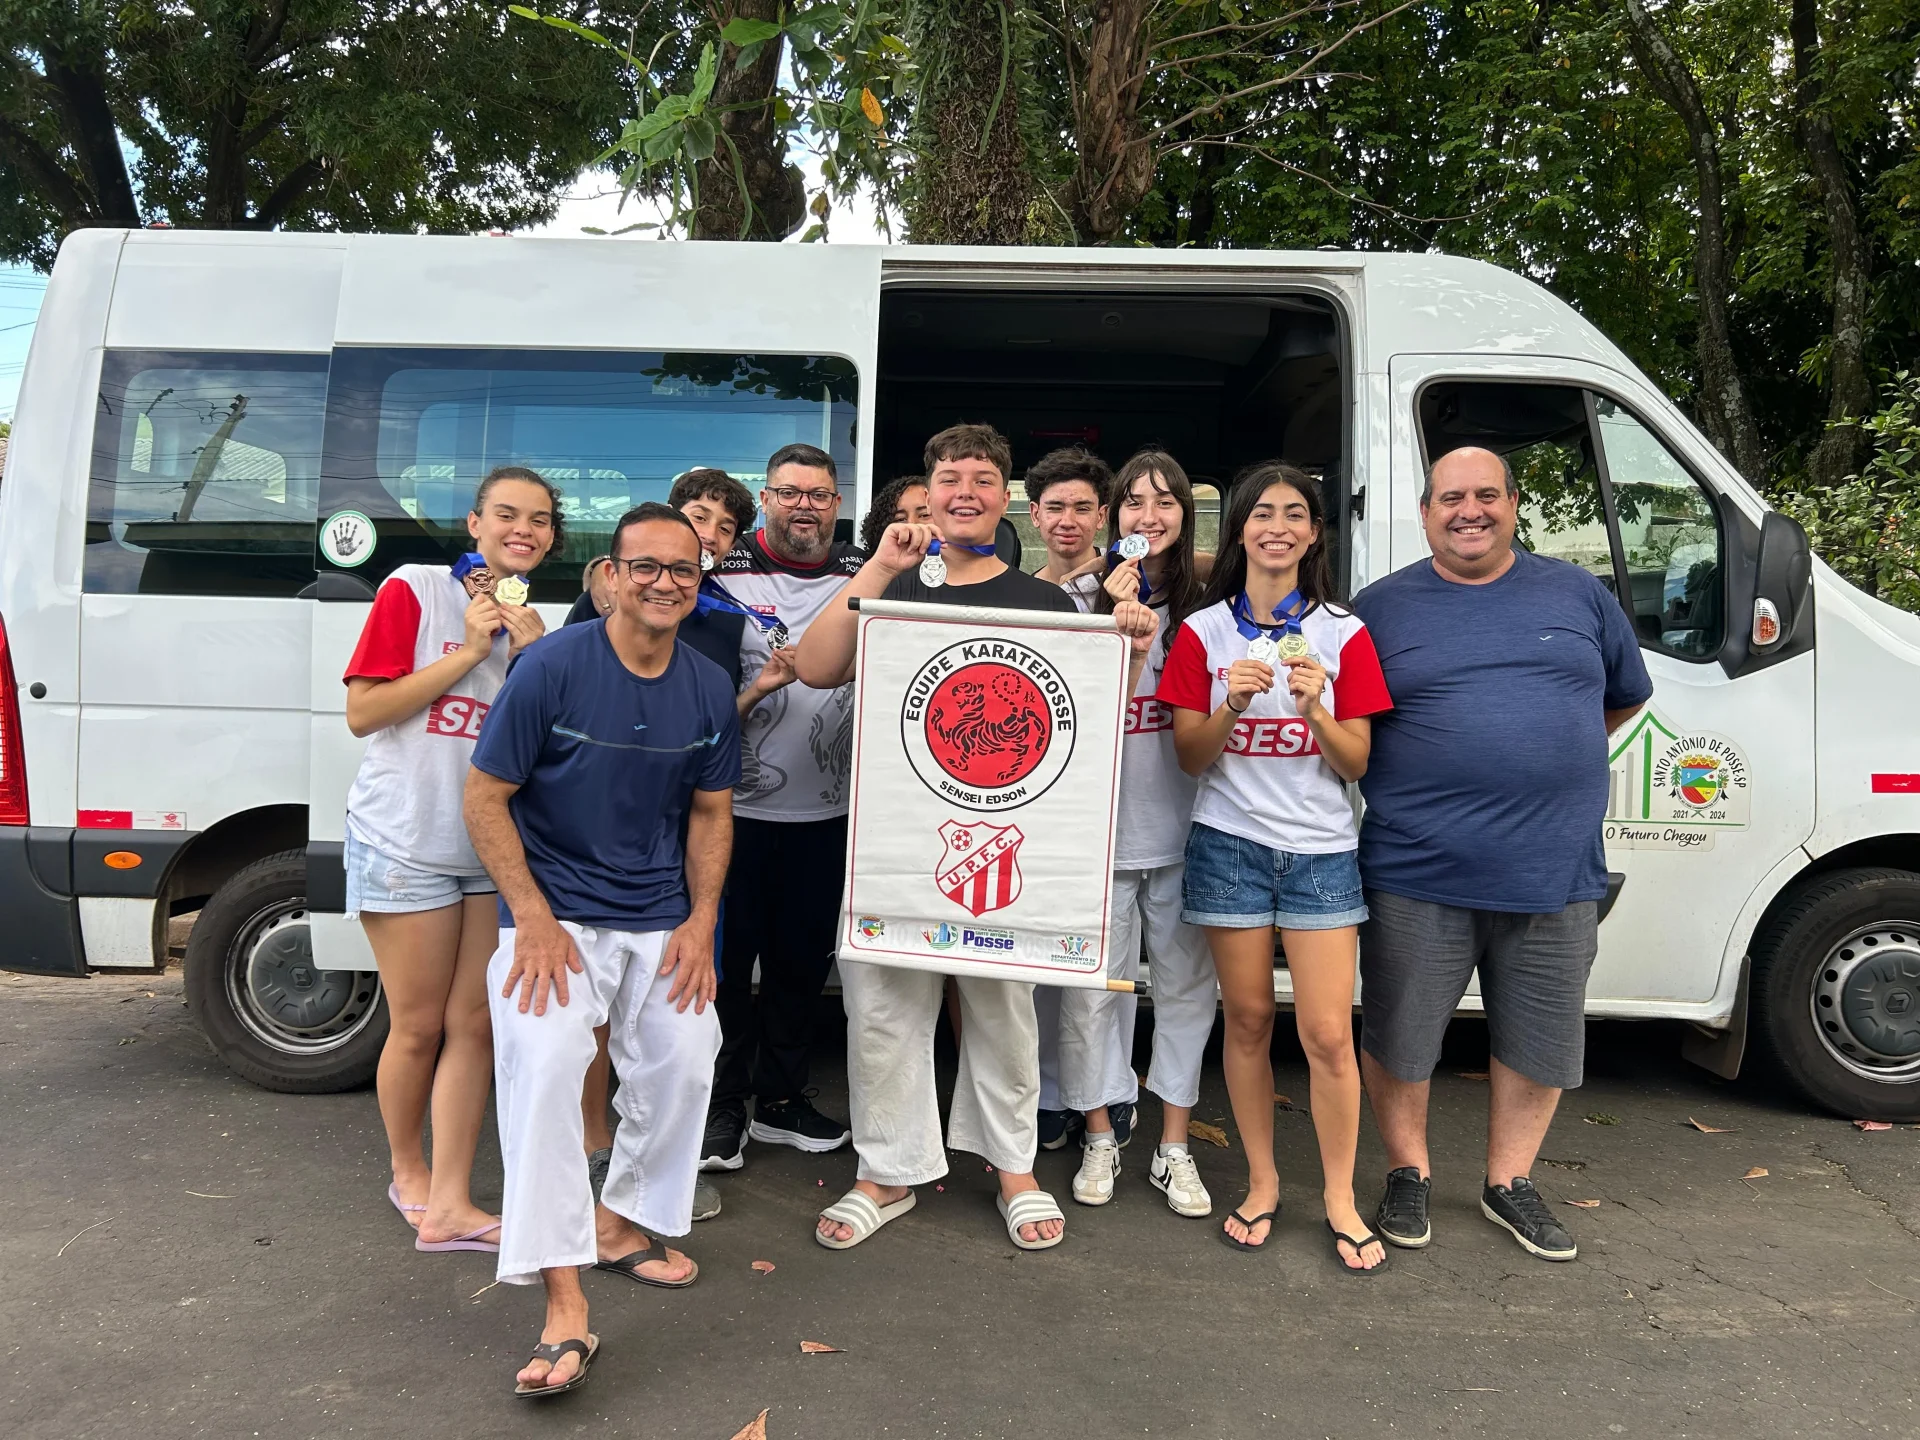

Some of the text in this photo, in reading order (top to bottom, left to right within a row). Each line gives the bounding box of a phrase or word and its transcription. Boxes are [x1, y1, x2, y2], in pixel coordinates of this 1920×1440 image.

[727, 549, 753, 559] RATE
[721, 560, 752, 570] POSSE
[905, 643, 1072, 732] EQUIPE KARATEPOSSE
[438, 701, 488, 734] SE
[1653, 758, 1671, 787] SANTO
[1665, 735, 1706, 760] ANTÔNIO
[1708, 739, 1723, 753] DE
[939, 780, 1027, 804] SENSEI EDSON
[1672, 809, 1726, 820] 2021 2024
[1605, 826, 1707, 847] O Futuro Chegou
[962, 929, 1015, 950] Posse
